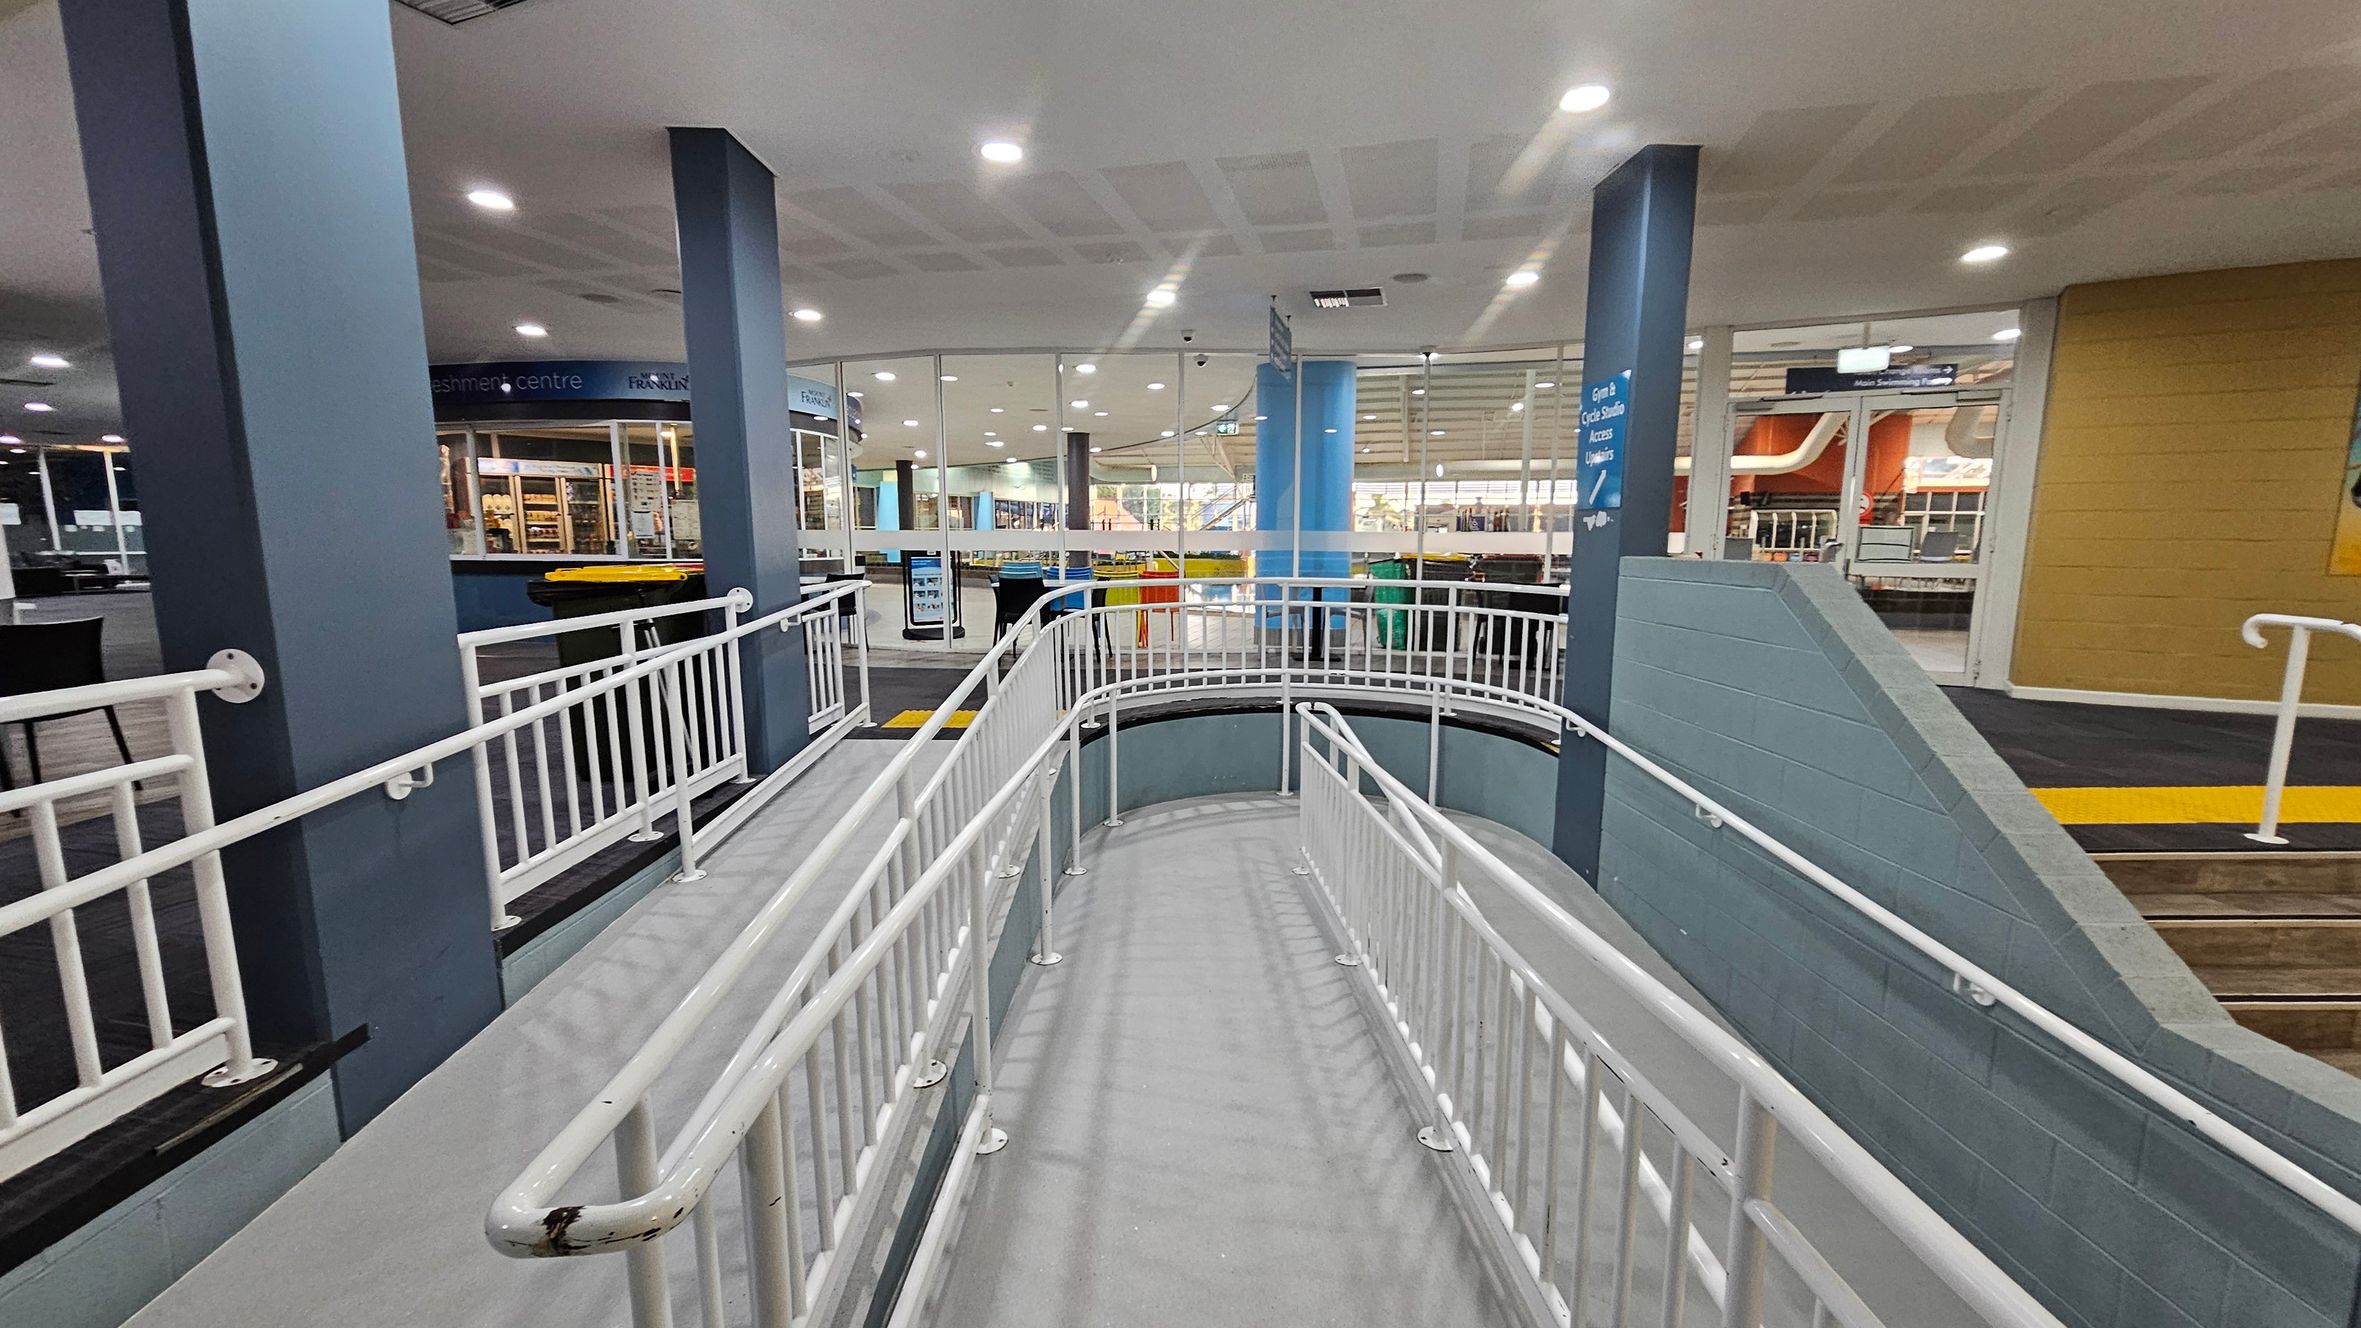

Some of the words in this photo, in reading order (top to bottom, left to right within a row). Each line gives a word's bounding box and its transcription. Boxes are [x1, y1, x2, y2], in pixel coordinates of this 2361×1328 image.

[516, 371, 583, 391] centre
[628, 375, 689, 391] FRANKLIN
[1592, 387, 1609, 403] Gym
[1582, 408, 1601, 427] Cycle
[1601, 401, 1625, 420] Studio
[1589, 428, 1613, 444] Access
[1585, 447, 1614, 467] Upstairs
